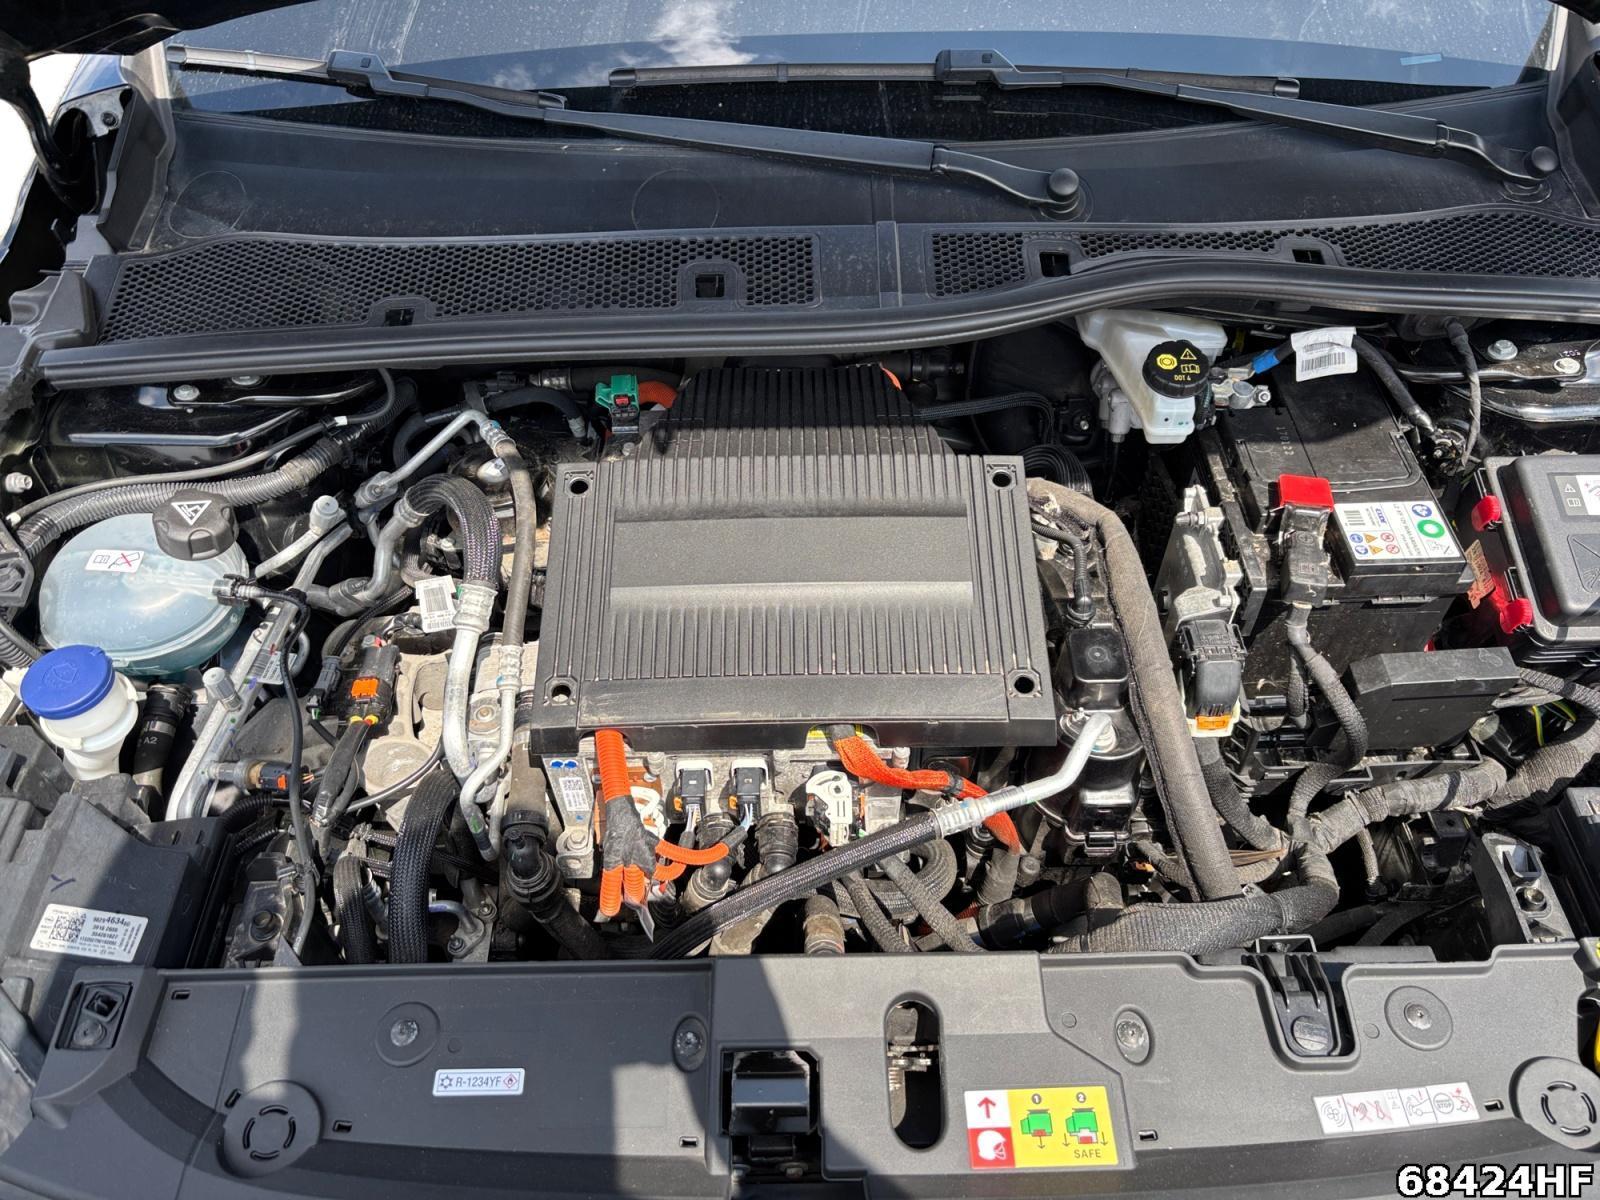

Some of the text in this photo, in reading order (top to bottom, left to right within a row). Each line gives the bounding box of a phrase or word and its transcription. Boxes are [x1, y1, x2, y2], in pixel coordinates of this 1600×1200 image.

[1174, 374, 1186, 382] DOT
[455, 1076, 501, 1088] R-1234YF
[1437, 1102, 1453, 1110] STOP
[1074, 1148, 1102, 1159] SAFE
